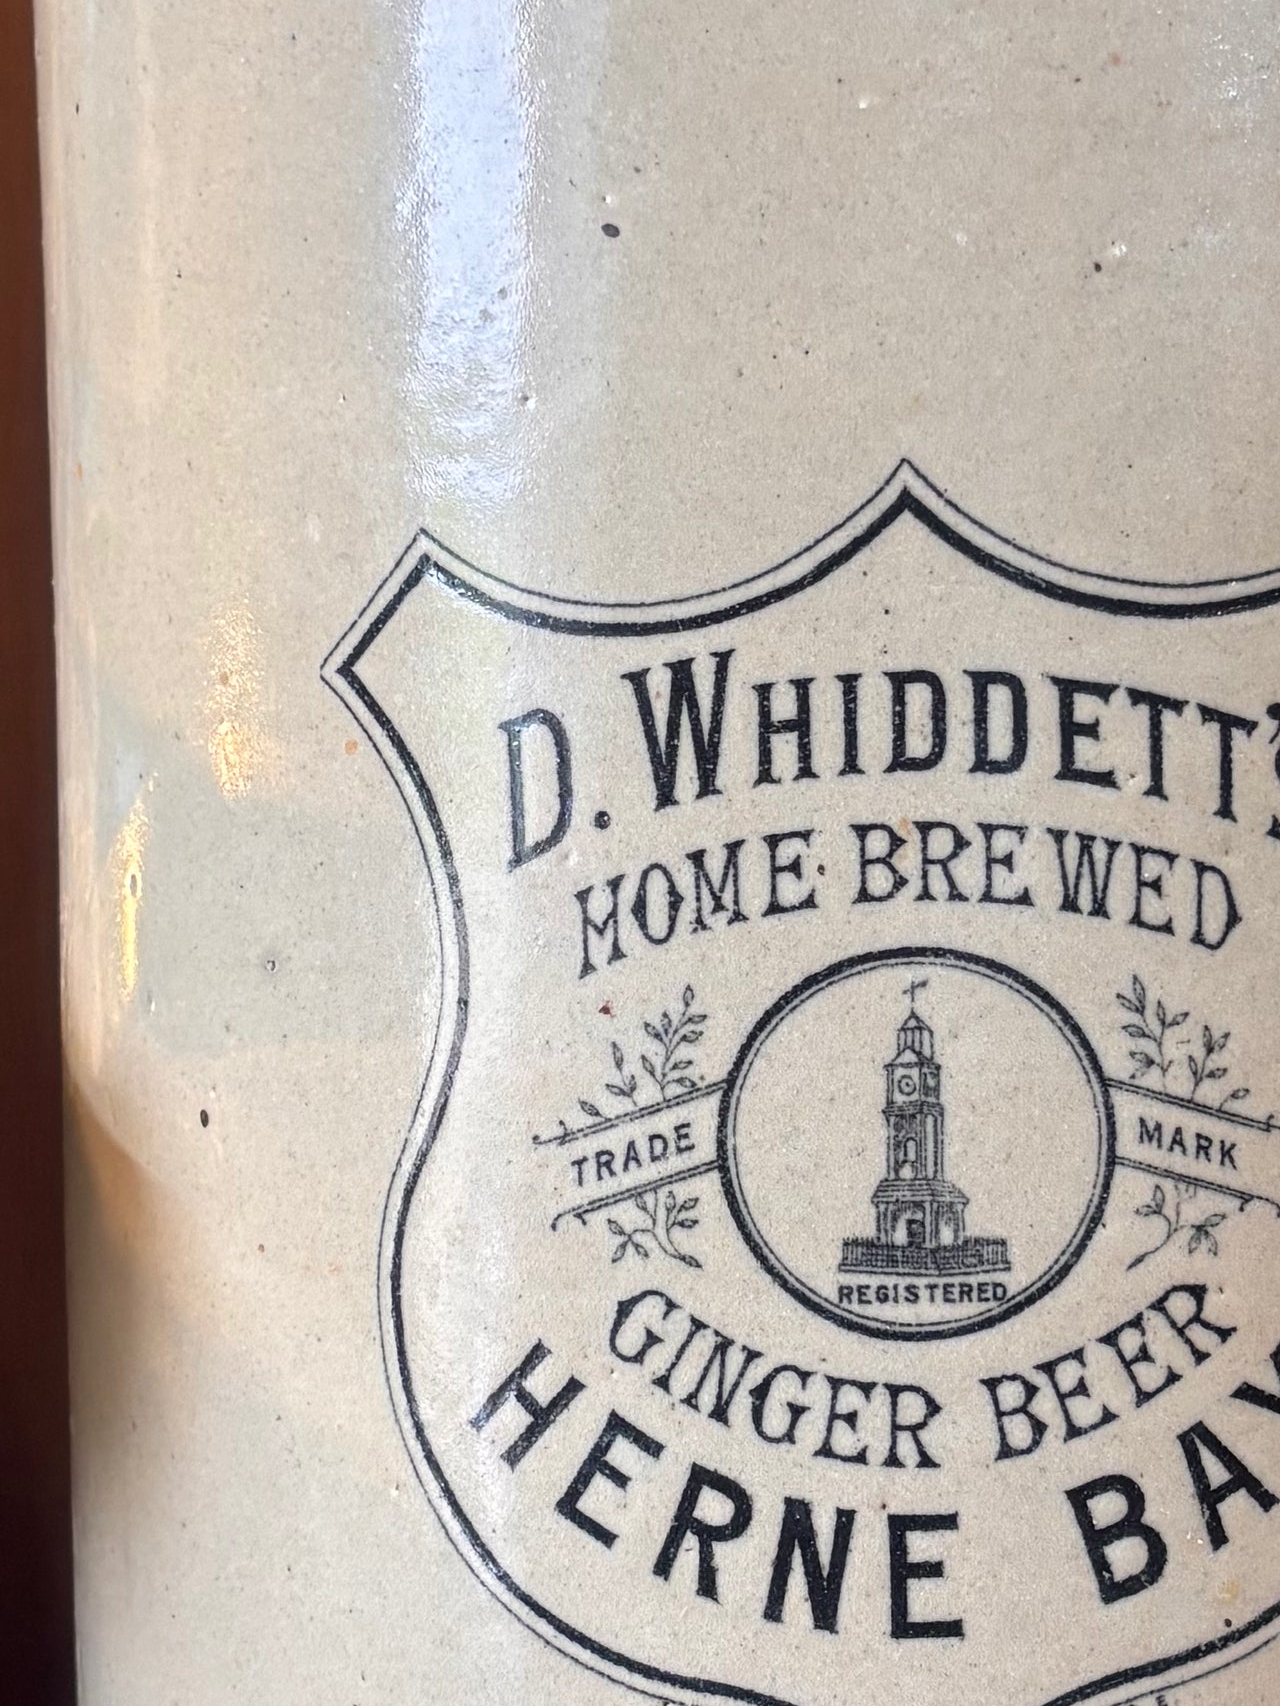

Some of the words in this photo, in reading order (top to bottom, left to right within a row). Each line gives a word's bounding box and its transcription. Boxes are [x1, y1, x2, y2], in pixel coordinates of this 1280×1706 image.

[497, 706, 611, 874] D.
[573, 828, 820, 980] HOME
[849, 820, 1243, 951] BREWED
[570, 1121, 696, 1187] TRADE
[1137, 1116, 1238, 1171] MARK
[837, 1281, 1009, 1305] REGISTERED
[608, 1289, 943, 1469] GINGER
[978, 1282, 1238, 1462] BEER
[469, 1337, 966, 1640] HERNE
